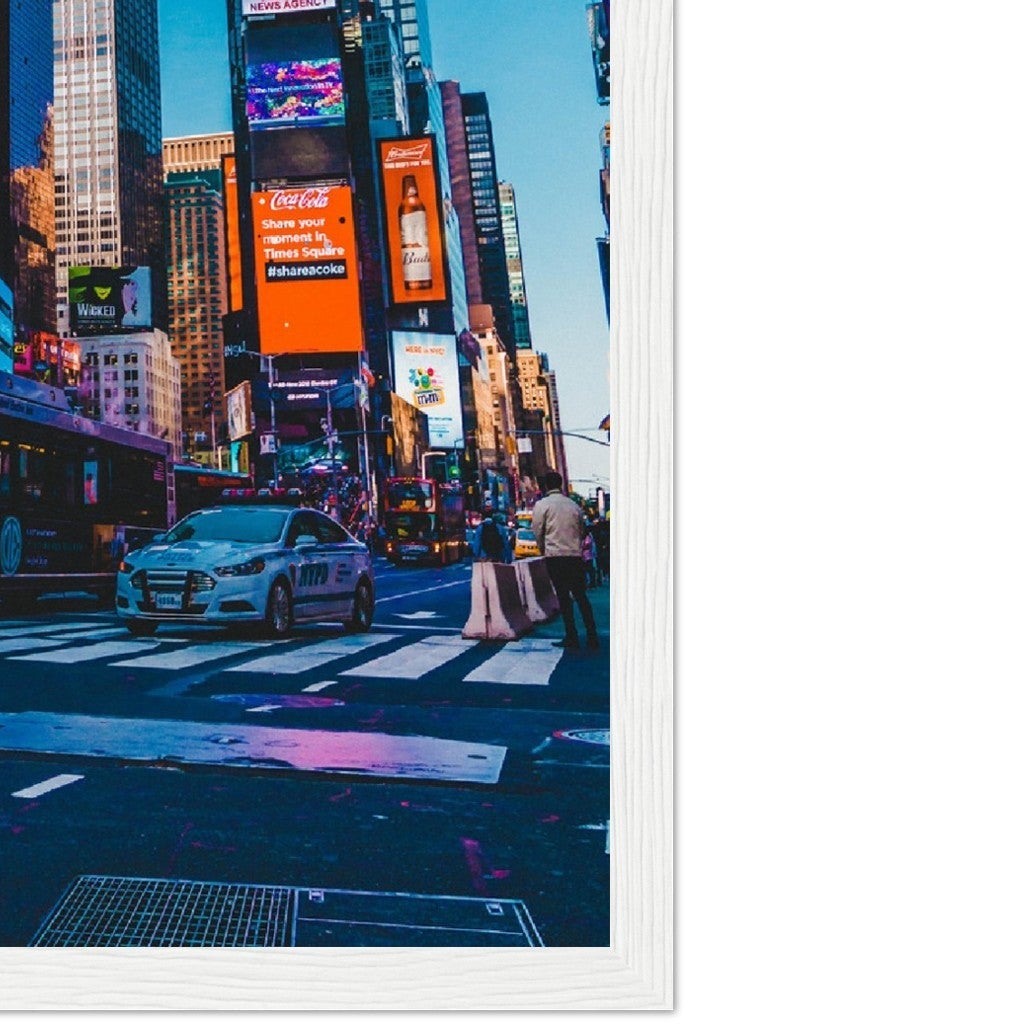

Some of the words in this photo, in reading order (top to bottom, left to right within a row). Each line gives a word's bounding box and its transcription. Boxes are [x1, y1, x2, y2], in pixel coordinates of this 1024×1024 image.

[250, 1, 282, 12] NEWS
[261, 218, 295, 229] Share
[298, 218, 325, 228] your
[262, 232, 312, 244] moment
[315, 231, 327, 241] in
[263, 248, 299, 259] Times
[302, 246, 345, 258] Square
[267, 263, 345, 277] #shareacoke
